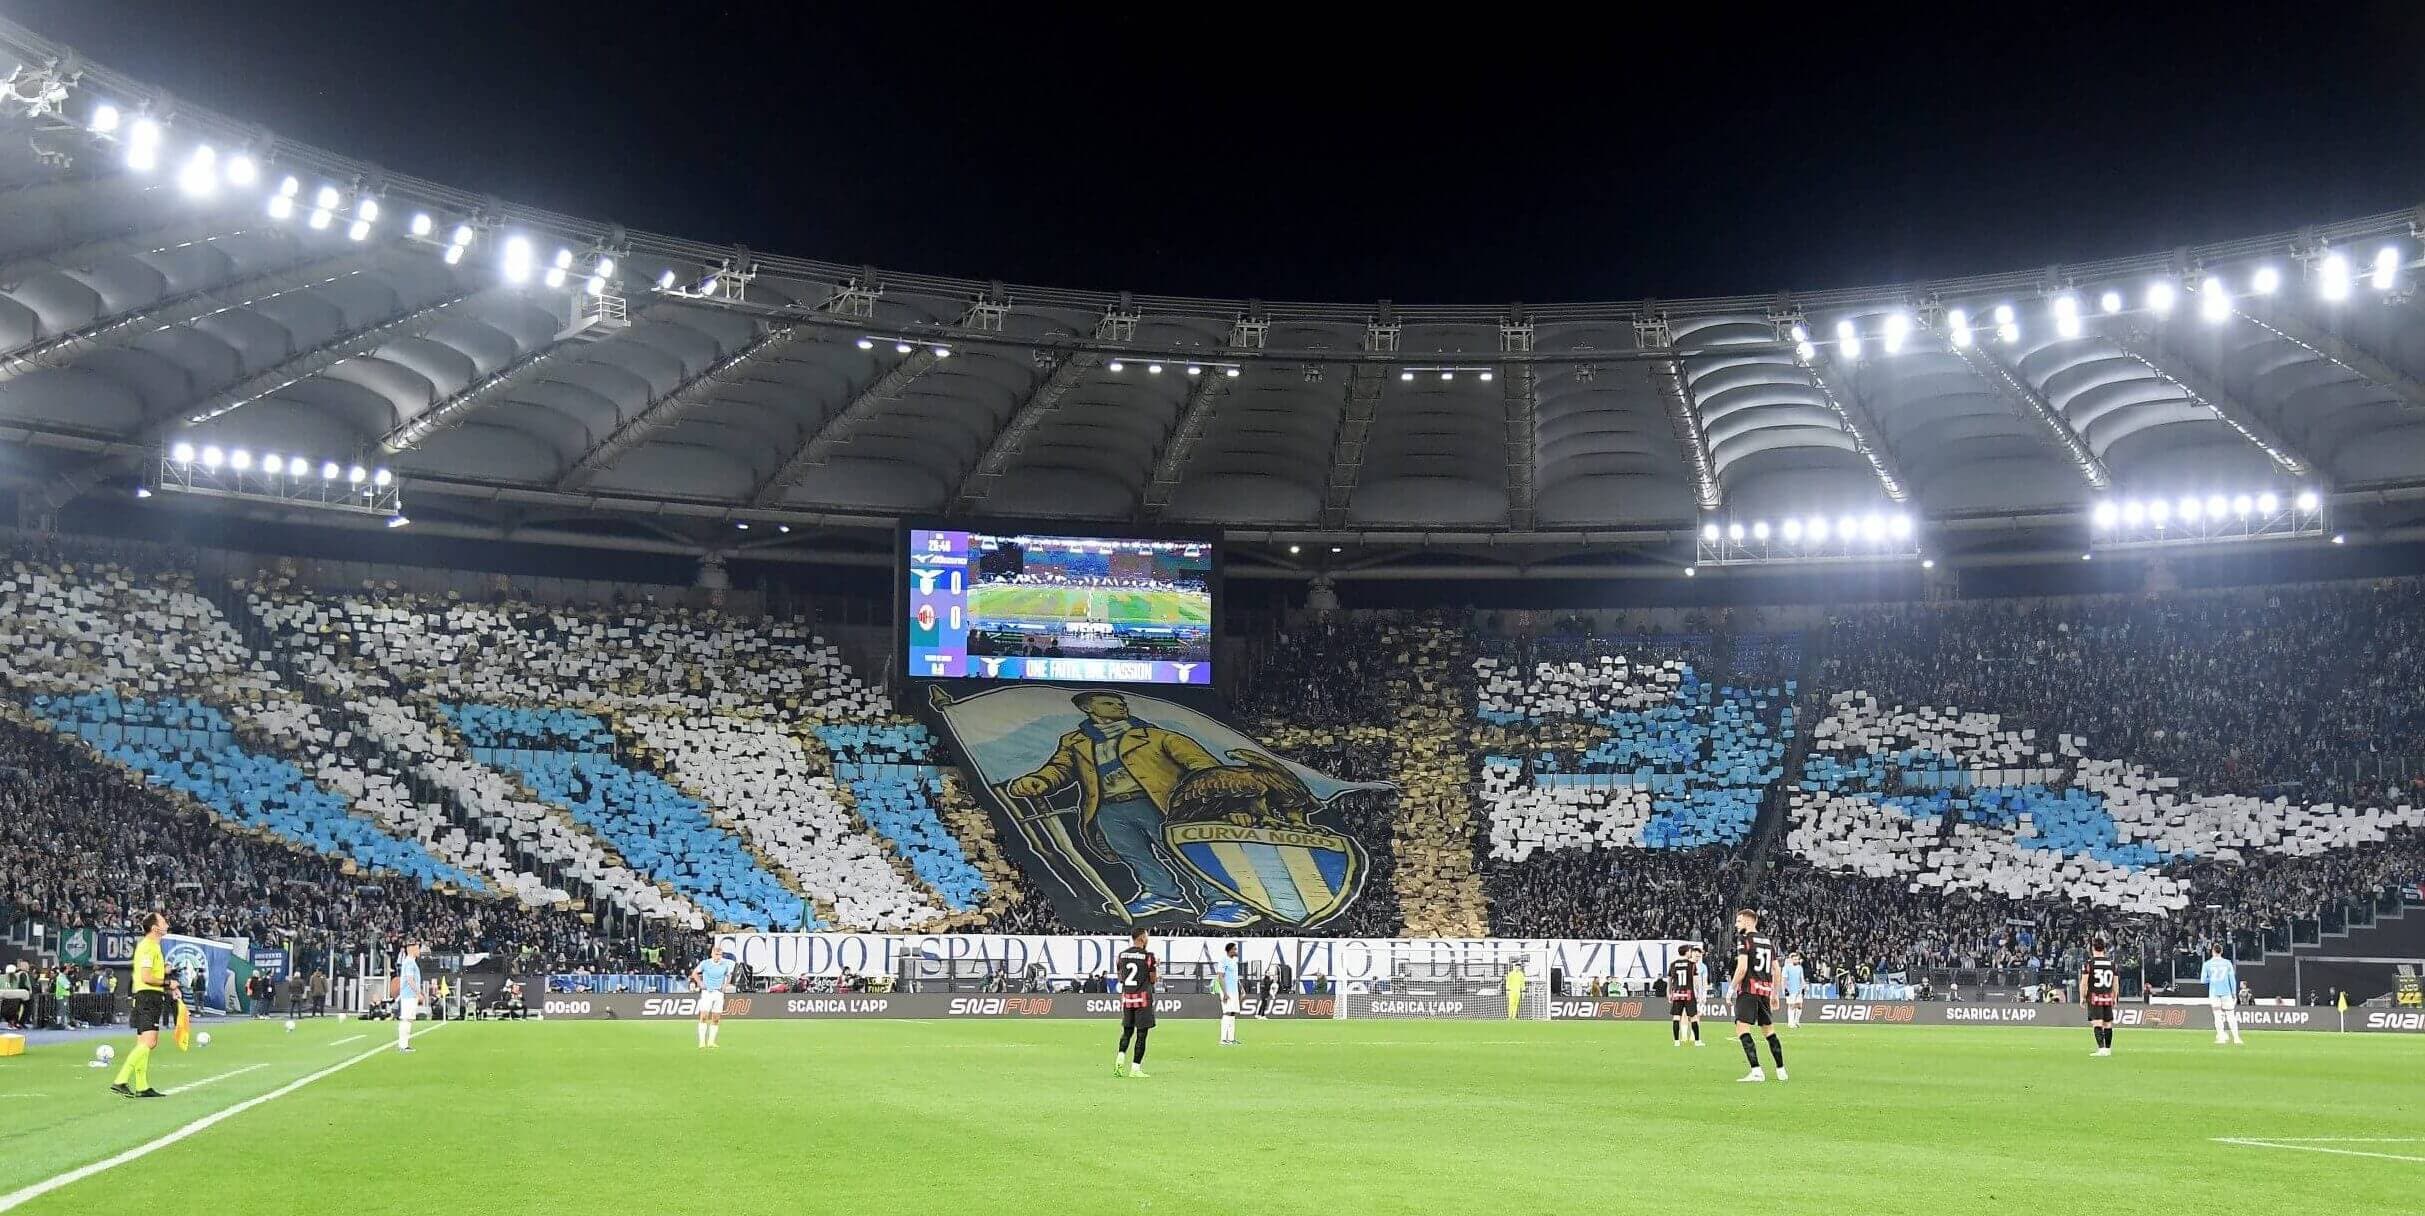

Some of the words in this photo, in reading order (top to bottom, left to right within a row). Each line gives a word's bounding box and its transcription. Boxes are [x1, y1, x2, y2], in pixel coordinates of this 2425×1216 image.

[1109, 662, 1153, 681] PASSION
[1181, 826, 1262, 841] CURVA
[1268, 831, 1338, 848] NORD
[719, 935, 868, 975] SCUDO
[881, 937, 905, 976] E
[919, 936, 1061, 977] SPADA
[1753, 946, 1772, 974] 31
[1124, 962, 1138, 987] 2
[1675, 969, 1687, 986] 11
[2093, 968, 2114, 988] 30
[544, 1000, 591, 1014] 00:00
[787, 999, 847, 1013] SCARICA
[850, 999, 888, 1013] L'APP
[1371, 1001, 1427, 1014] SCARICA
[1429, 1001, 1463, 1014] L'APP
[1946, 1007, 1999, 1020] SCARICA
[2002, 1008, 2037, 1021] L'APP
[2274, 1011, 2309, 1024] L'APP
